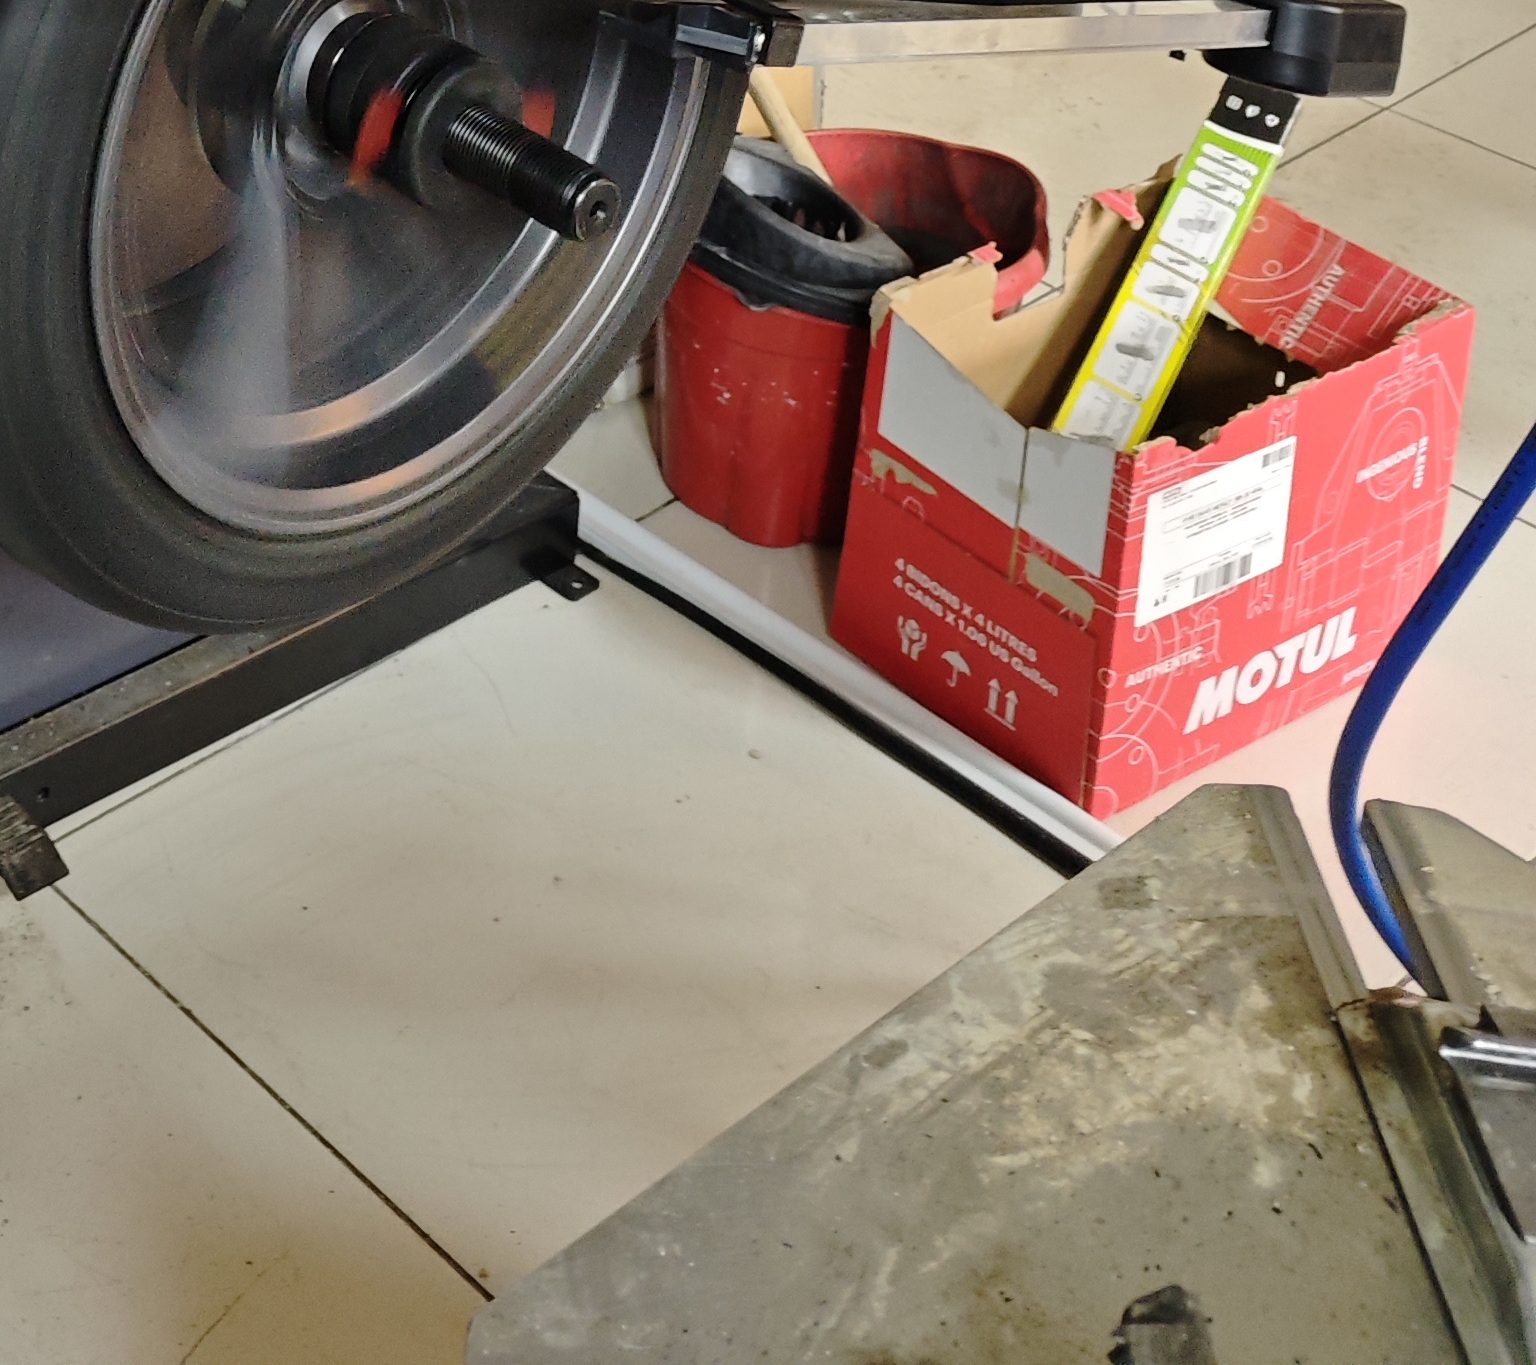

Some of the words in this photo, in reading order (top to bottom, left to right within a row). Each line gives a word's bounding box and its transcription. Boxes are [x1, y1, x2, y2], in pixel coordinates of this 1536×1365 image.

[1279, 263, 1346, 349] AUTHENTIC
[1412, 436, 1430, 489] BLEND
[904, 582, 944, 617] CANS
[988, 640, 1010, 663] US
[974, 613, 985, 626] 4
[986, 620, 1038, 662] LITRES
[1124, 646, 1204, 688] AUTHENTIC
[1182, 606, 1358, 735] MOTUL
